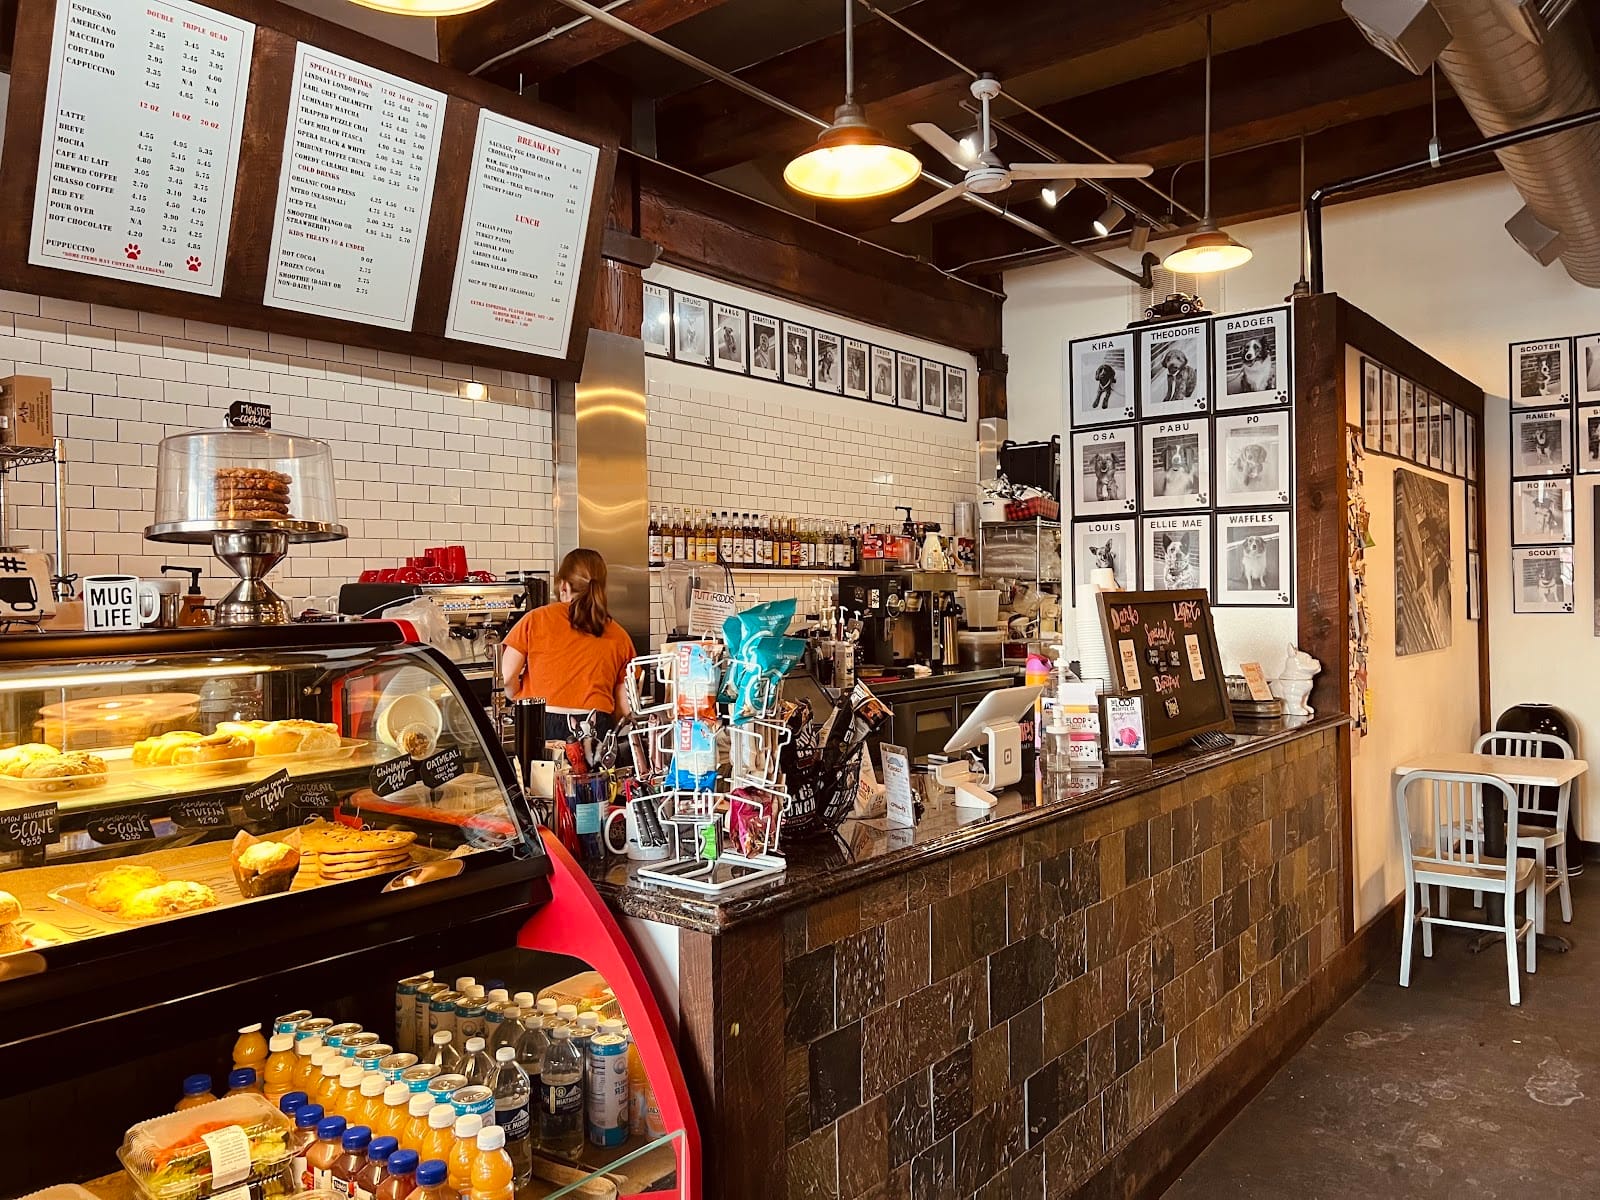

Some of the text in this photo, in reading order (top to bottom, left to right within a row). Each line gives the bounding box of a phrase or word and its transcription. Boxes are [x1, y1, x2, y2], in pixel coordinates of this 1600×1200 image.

[72, 2, 112, 21] ESPRESSO
[70, 16, 117, 36] AMERICANO
[146, 9, 229, 42] DOUBLE TRIPLE QUAD
[69, 29, 115, 49] MACCHIATO
[67, 43, 105, 59] CORTADO
[66, 56, 116, 76] CAPPUCCINO
[304, 71, 357, 94] LINDSAY LONDON
[310, 62, 373, 89] SPECIALTY DRINKS
[303, 82, 373, 111] EARL GREY CREAMETTE
[140, 101, 149, 109] 12
[149, 104, 160, 112] OZ
[181, 113, 191, 121] OZ
[301, 94, 360, 118] LUMINARY MATCHA
[60, 109, 86, 122] LATTE
[298, 117, 315, 127] CAFE
[58, 122, 85, 135] BREVE
[330, 115, 352, 127] PUZZLE
[353, 123, 368, 133] CHAI
[57, 135, 85, 148] MOCHA
[296, 140, 323, 154] TRIBUNE
[297, 129, 366, 155] OPERA BLACK WHITE
[517, 135, 561, 156] BREAKFAST
[55, 148, 76, 159] CAFE
[78, 154, 89, 162] AU
[91, 157, 110, 167] LAIT
[294, 152, 364, 177] COMEDY CARAMEL ROLL
[54, 161, 87, 175] BREWED
[89, 170, 118, 182] COFFEE
[297, 164, 340, 180] COLD DRINKS
[52, 174, 84, 187] GRASSO
[85, 182, 114, 194] COFFEE
[290, 186, 310, 196] NITRO
[291, 175, 319, 186] ORGANIC
[320, 182, 336, 192] COLD
[51, 187, 68, 196] RED
[69, 191, 84, 200] EYE
[49, 200, 72, 211] POUR
[73, 205, 95, 215] OVER
[48, 213, 66, 222] HOT
[67, 217, 113, 232] CHOCOLATE
[515, 214, 540, 228] LUNCH
[288, 229, 304, 237] KIDS
[46, 239, 96, 254] PUPPUCCINO
[280, 260, 304, 270] FROZEN
[295, 252, 316, 262] COCOA
[1227, 316, 1274, 330] BADGER
[1150, 326, 1200, 341] THEODORE
[1092, 341, 1114, 351] KIRA
[1520, 343, 1560, 353] SCOOTER
[1247, 415, 1259, 424] PO
[1525, 411, 1556, 421] RAMEN
[1093, 432, 1115, 441] OSA
[1159, 423, 1190, 434] PABU
[1150, 518, 1203, 529] ELLIE MAE
[1229, 514, 1274, 524] WAFFLES
[1088, 523, 1121, 533] LOUIS
[91, 587, 133, 606] MUG
[93, 607, 133, 628] LIFE
[376, 757, 411, 778] CINNAMON
[426, 750, 459, 770] OATMEAL
[0, 807, 56, 825] EMON BLUEBERRY
[186, 806, 225, 818] MUFFIN
[9, 817, 55, 840] SCONE
[107, 816, 150, 835] SCONE
